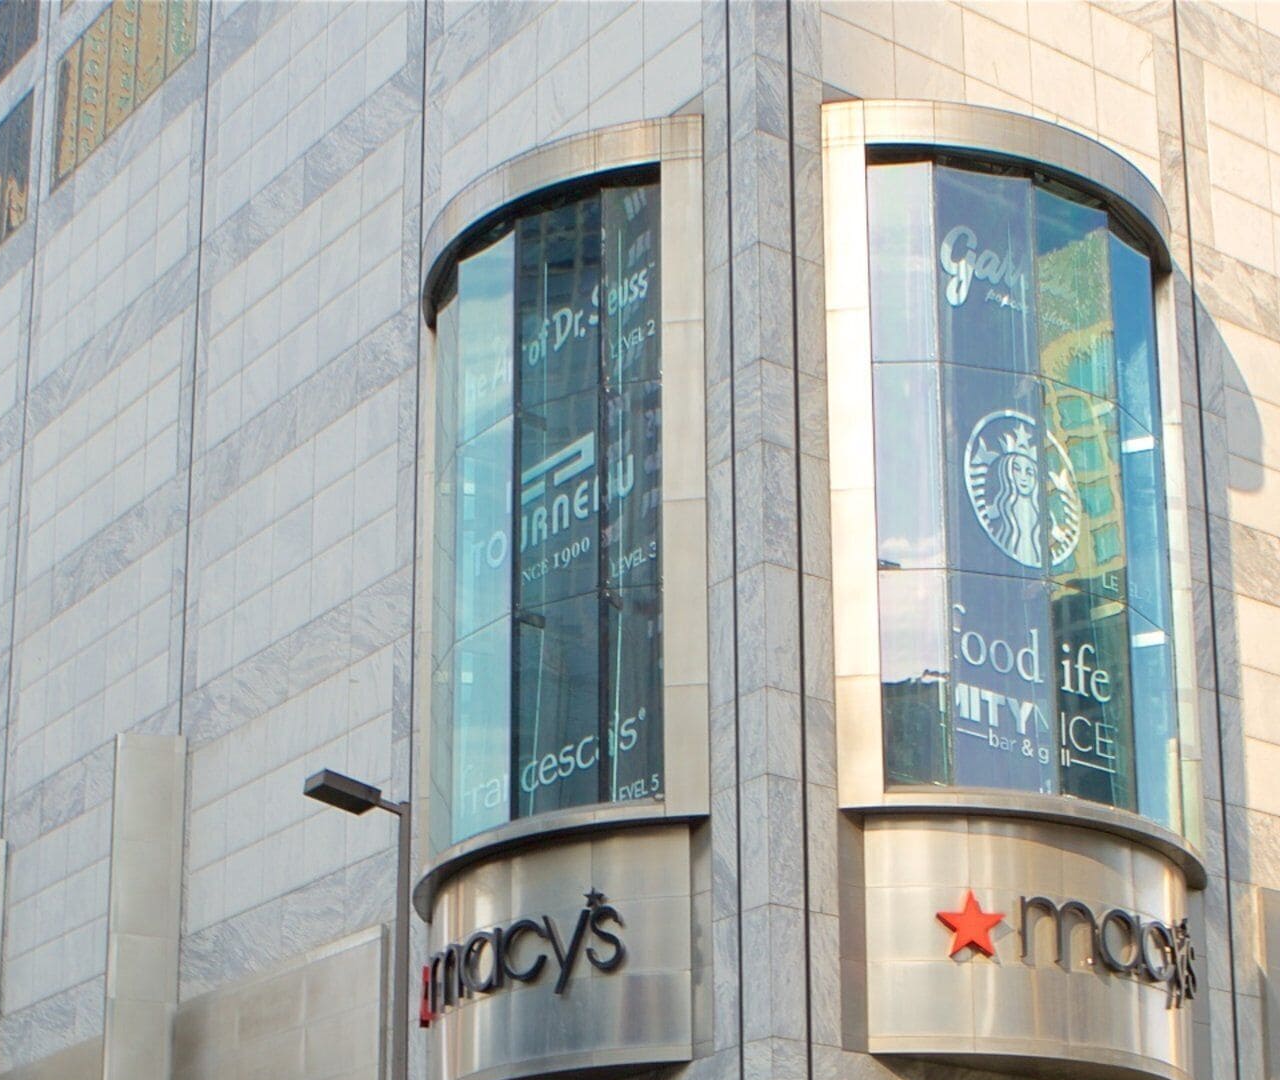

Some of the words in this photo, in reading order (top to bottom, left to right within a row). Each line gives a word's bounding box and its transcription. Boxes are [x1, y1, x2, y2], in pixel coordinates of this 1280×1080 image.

[553, 307, 586, 352] Dr.
[646, 320, 657, 338] 2
[552, 536, 591, 569] 1900
[988, 728, 1017, 752] bar
[1020, 737, 1034, 757] &
[650, 775, 661, 792] 5
